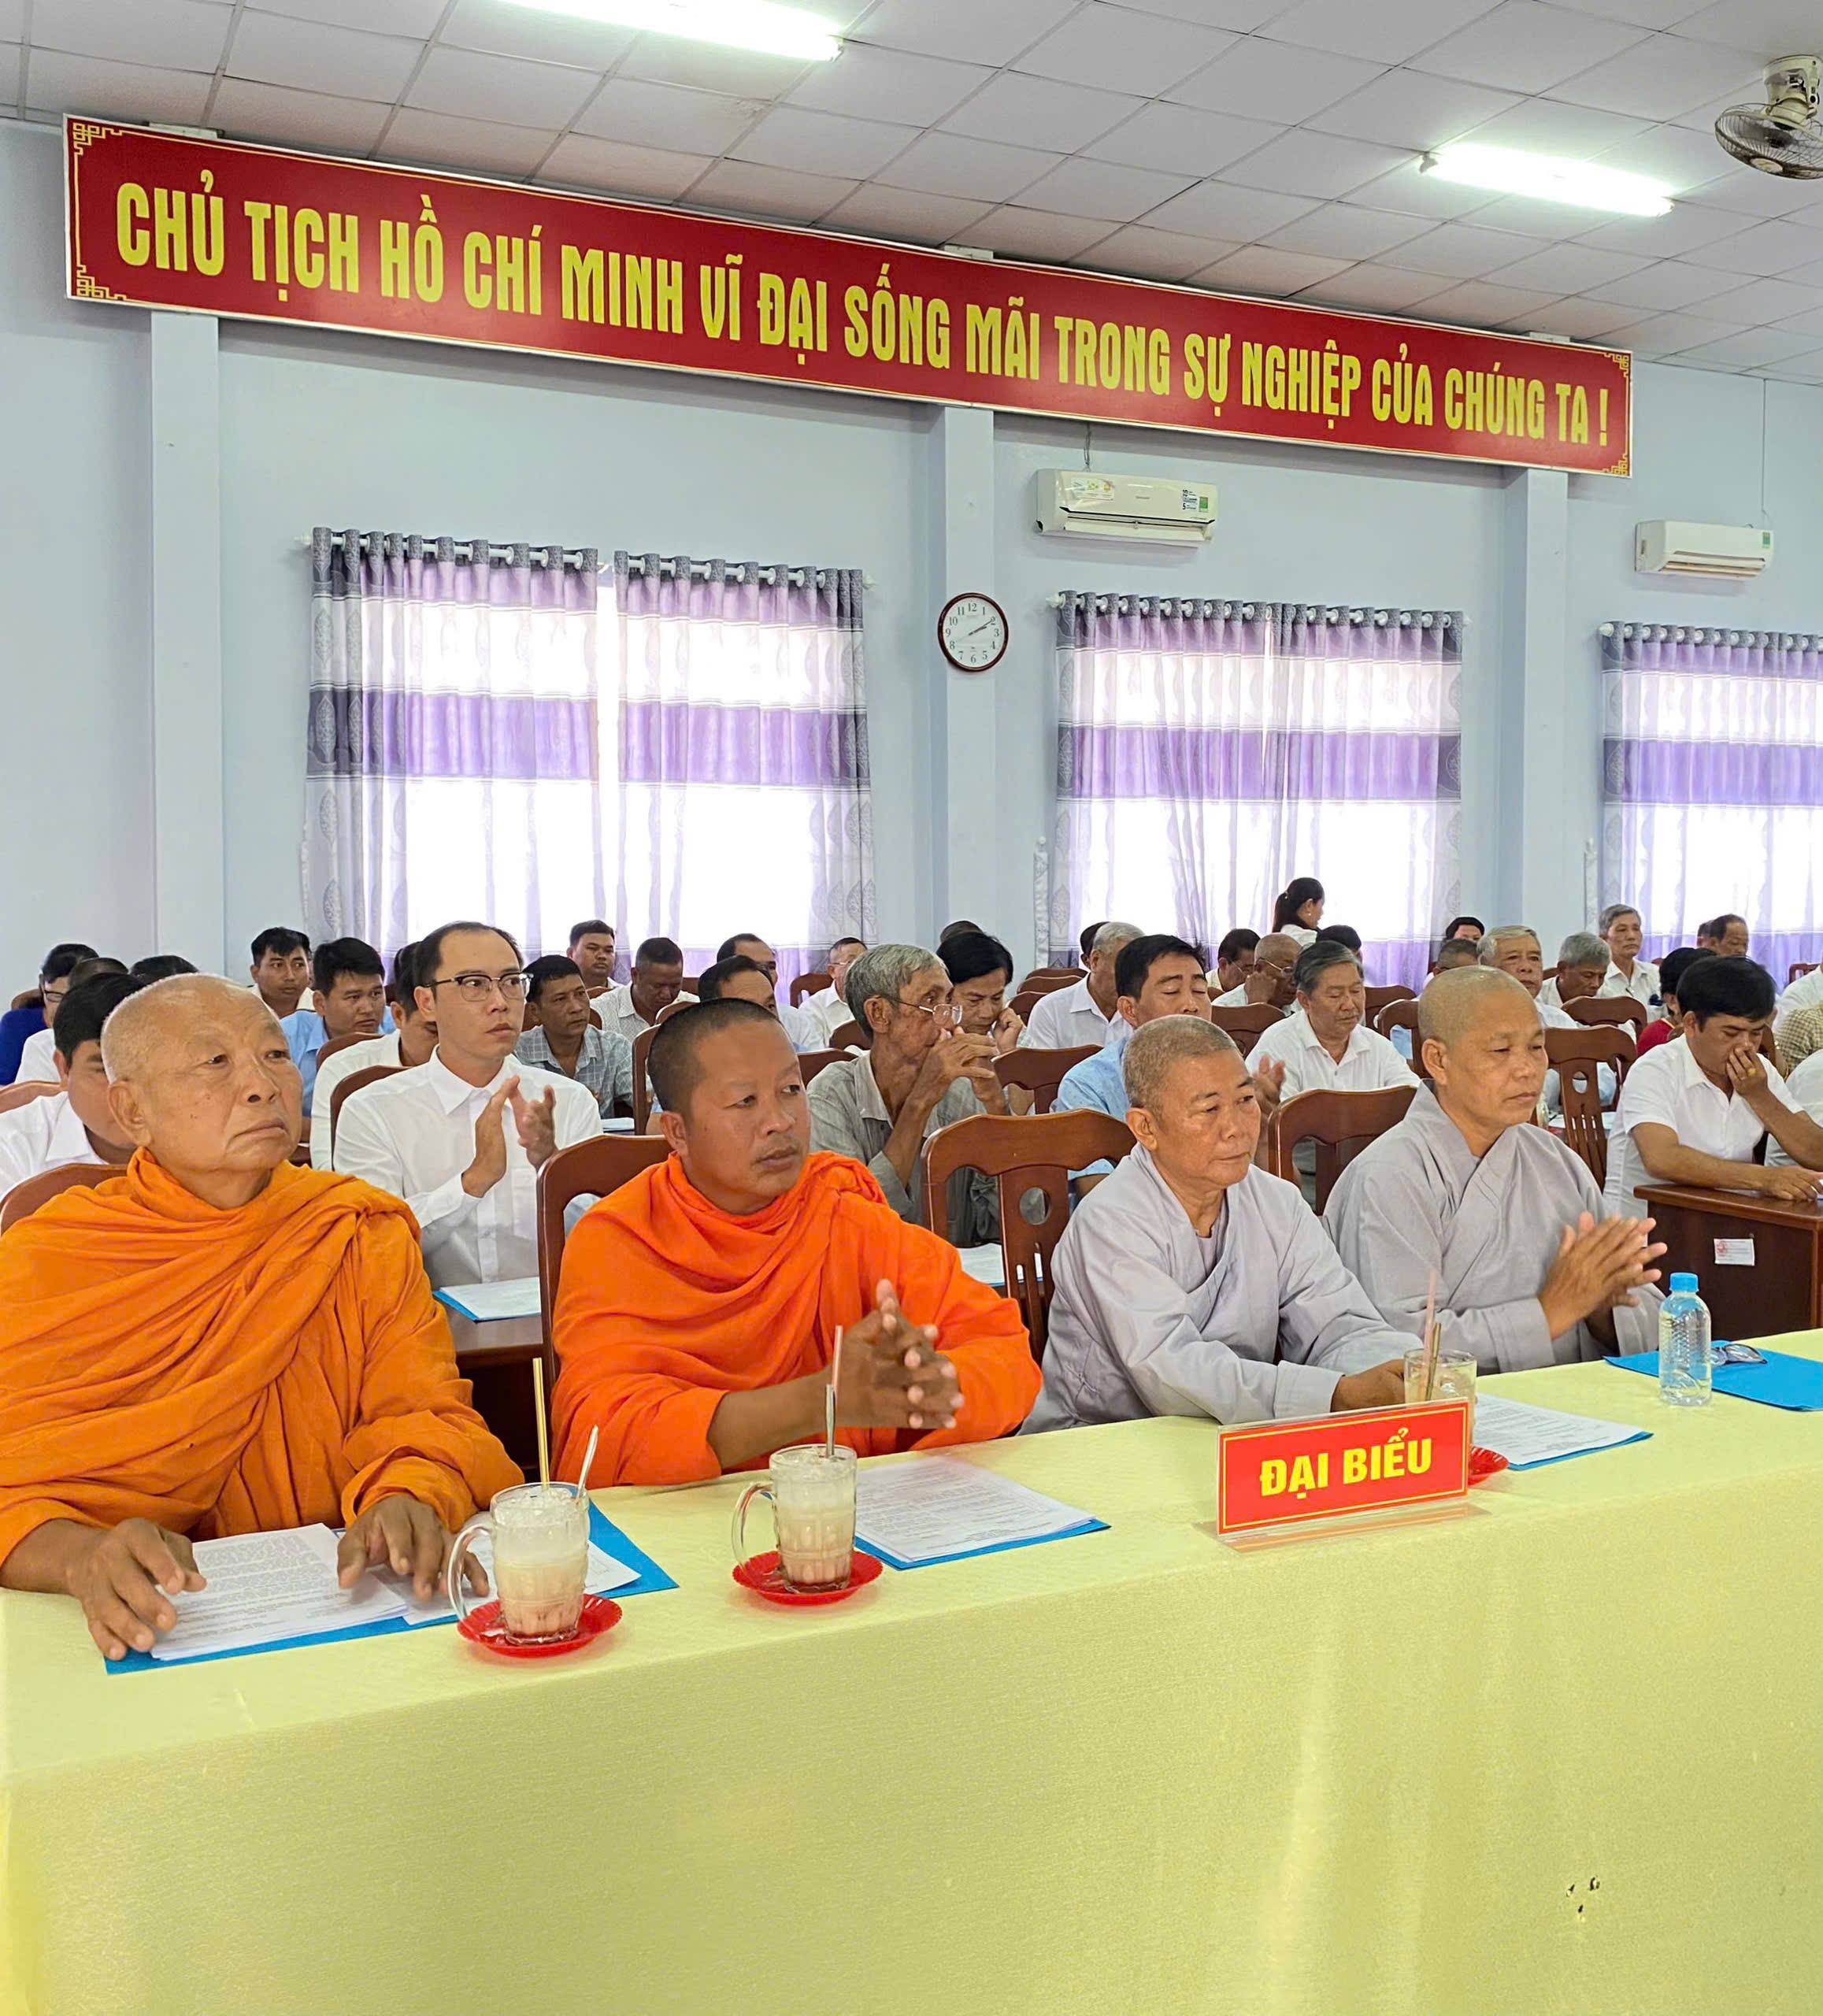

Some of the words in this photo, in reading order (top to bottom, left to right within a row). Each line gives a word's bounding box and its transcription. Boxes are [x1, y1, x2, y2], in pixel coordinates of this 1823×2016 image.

[117, 169, 225, 276] CHỦ
[243, 202, 361, 302] TỊCH
[380, 195, 446, 304] HỒ
[463, 225, 543, 317] CHÍ
[561, 244, 684, 335] MINH
[700, 253, 742, 342] VĨ
[756, 272, 828, 365] ĐẠI
[843, 262, 950, 369] SỐNG
[965, 297, 1040, 381] MÃI
[1054, 317, 1170, 396] TRONG
[1183, 332, 1231, 417] SỰ
[1242, 340, 1362, 429] NGHIỆP
[1372, 343, 1434, 427] CỦA
[1444, 361, 1546, 441] CHÚNG
[1555, 384, 1589, 446] TA
[958, 606, 965, 616] 11
[968, 602, 977, 612] 12
[949, 617, 958, 626] 10
[945, 628, 951, 637] 9
[994, 628, 1000, 637] 3
[949, 641, 955, 650] 8
[991, 640, 996, 650] 4
[958, 650, 964, 661] 7
[970, 654, 977, 663] 6
[982, 650, 988, 661] 5
[1259, 1453, 1329, 1500] ĐẠI
[1343, 1426, 1432, 1485] BIỂU
